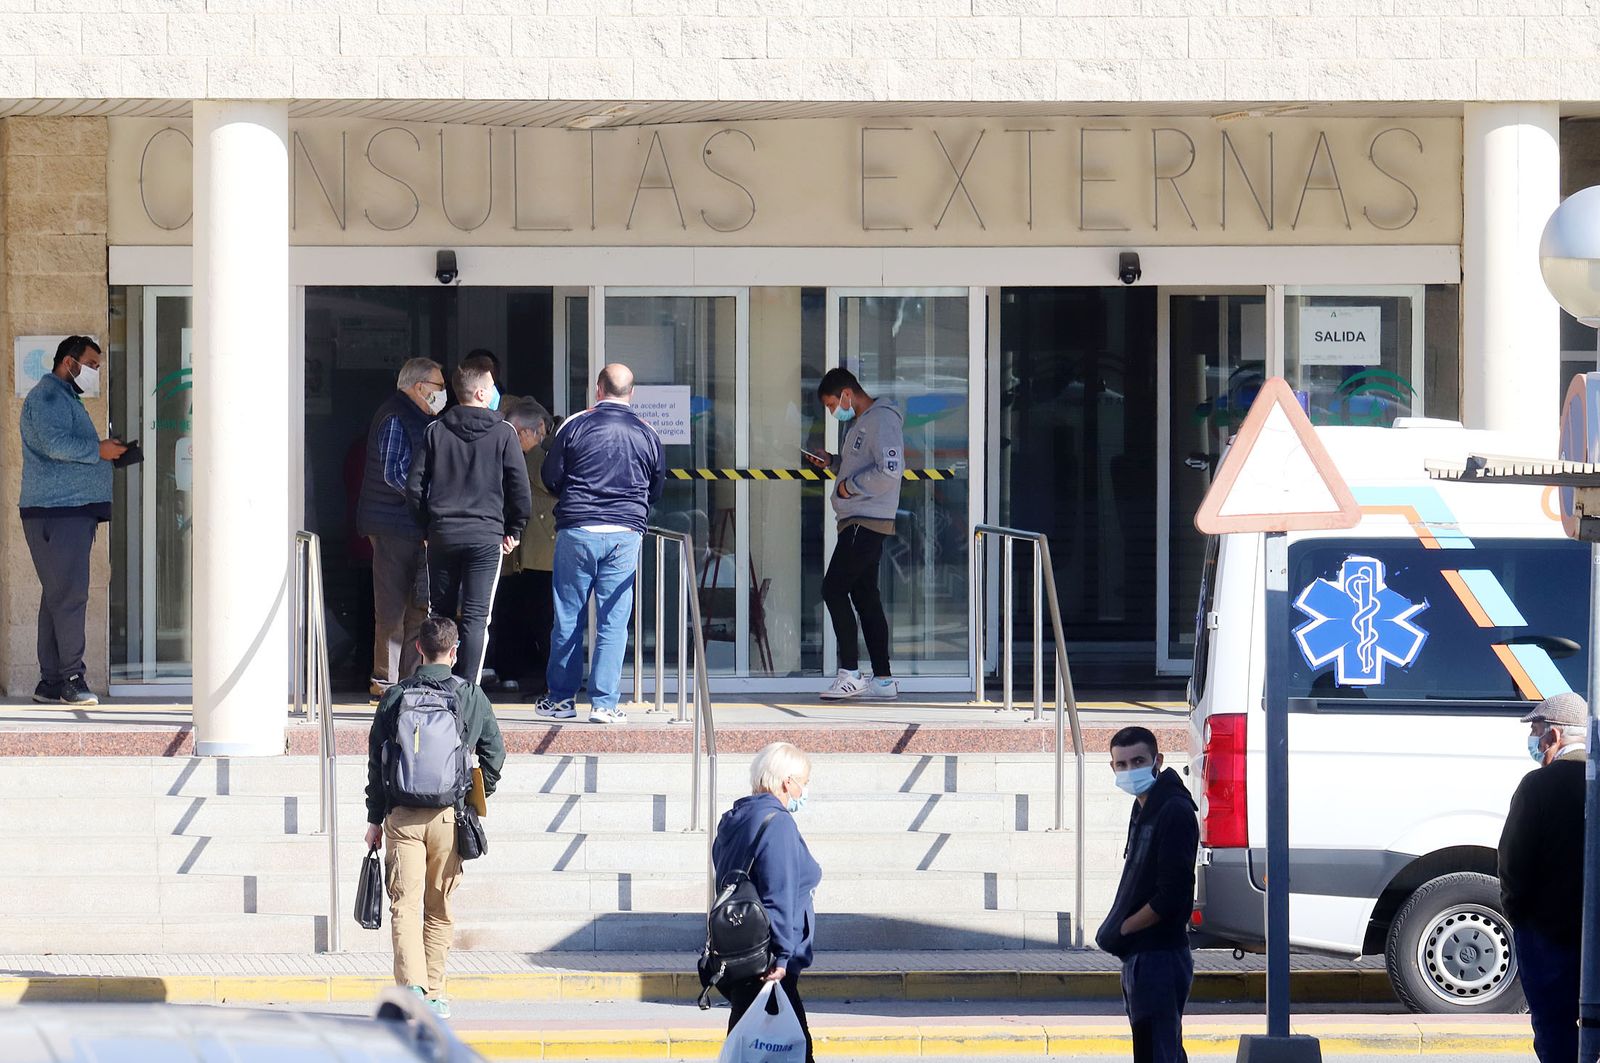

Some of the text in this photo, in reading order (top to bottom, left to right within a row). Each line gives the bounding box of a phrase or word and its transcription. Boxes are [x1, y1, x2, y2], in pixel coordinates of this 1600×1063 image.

[139, 126, 1424, 233] CNSULTAS EXTERNAS
[1314, 331, 1366, 342] SALIDA
[749, 1038, 794, 1052] Aromas
